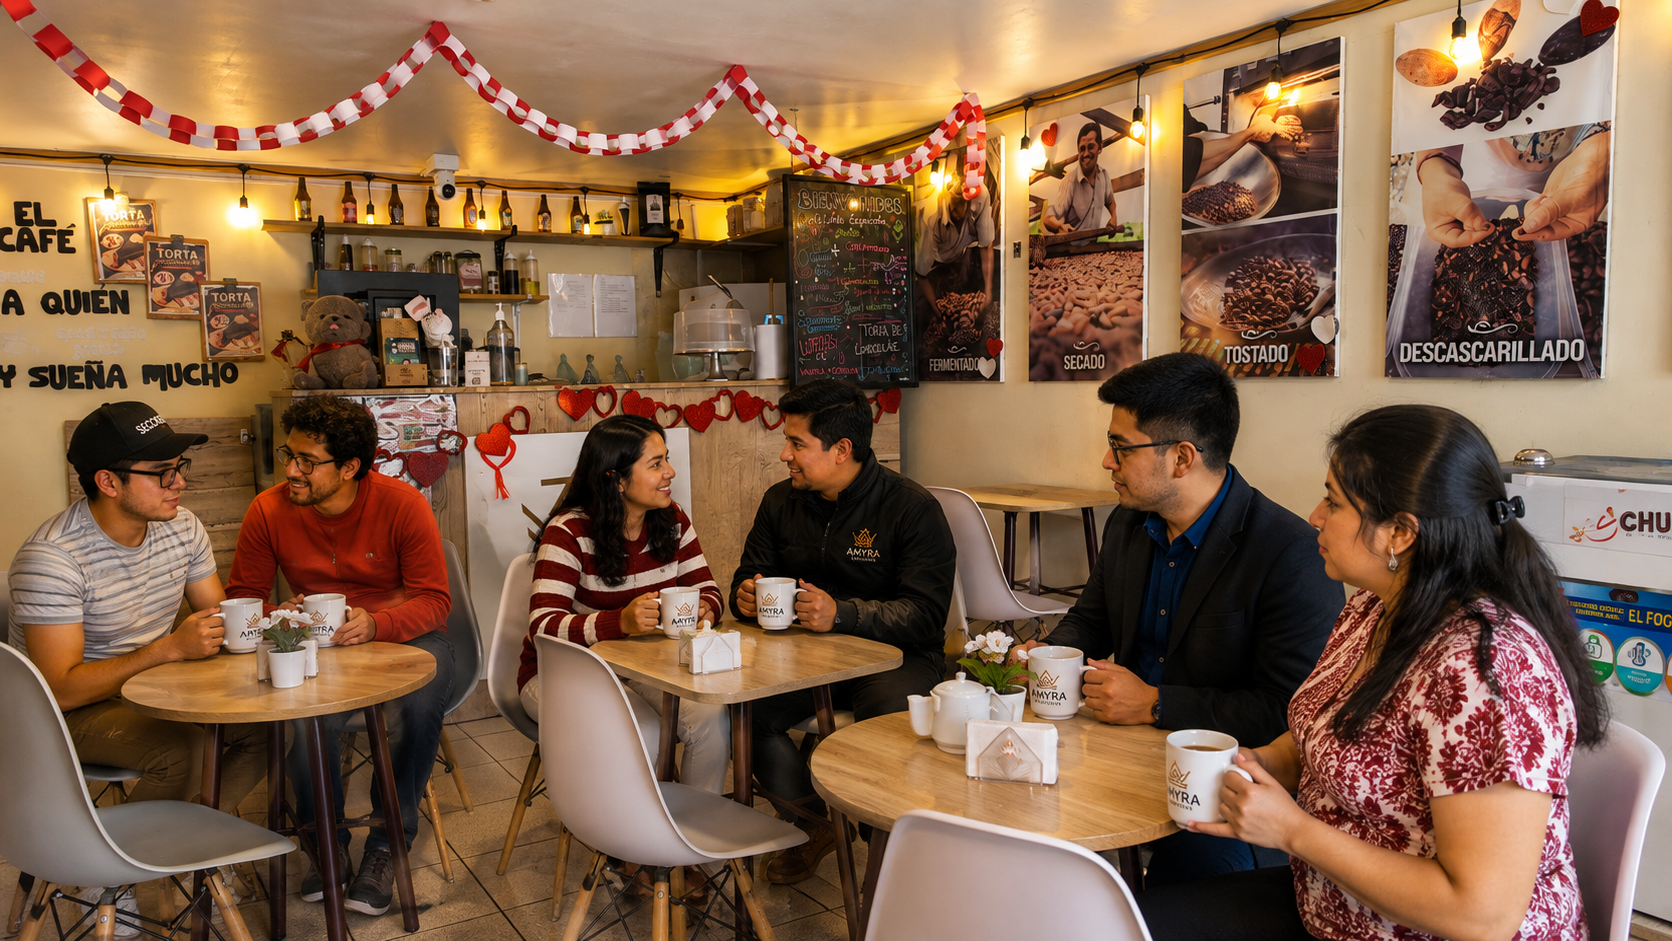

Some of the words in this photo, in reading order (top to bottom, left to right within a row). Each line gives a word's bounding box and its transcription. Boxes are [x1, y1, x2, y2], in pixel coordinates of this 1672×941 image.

[14, 201, 57, 227] EL
[102, 209, 145, 222] TORTA
[0, 223, 76, 254] CAFÉ
[155, 247, 198, 260] TORTA
[1, 289, 25, 315] A
[40, 283, 130, 315] QUIÉN
[210, 292, 251, 302] TORTA
[1224, 344, 1289, 364] TOSTADO
[1400, 339, 1585, 363] DESCASCARILLADO
[1063, 354, 1105, 370] SECADO
[0, 365, 16, 388] Y
[28, 361, 128, 390] SUEÑA
[142, 362, 239, 391] MUCHO
[1620, 511, 1671, 533] CHU
[846, 547, 880, 558] AMYRA
[1628, 609, 1643, 624] EL
[1031, 688, 1066, 701] AMYRA
